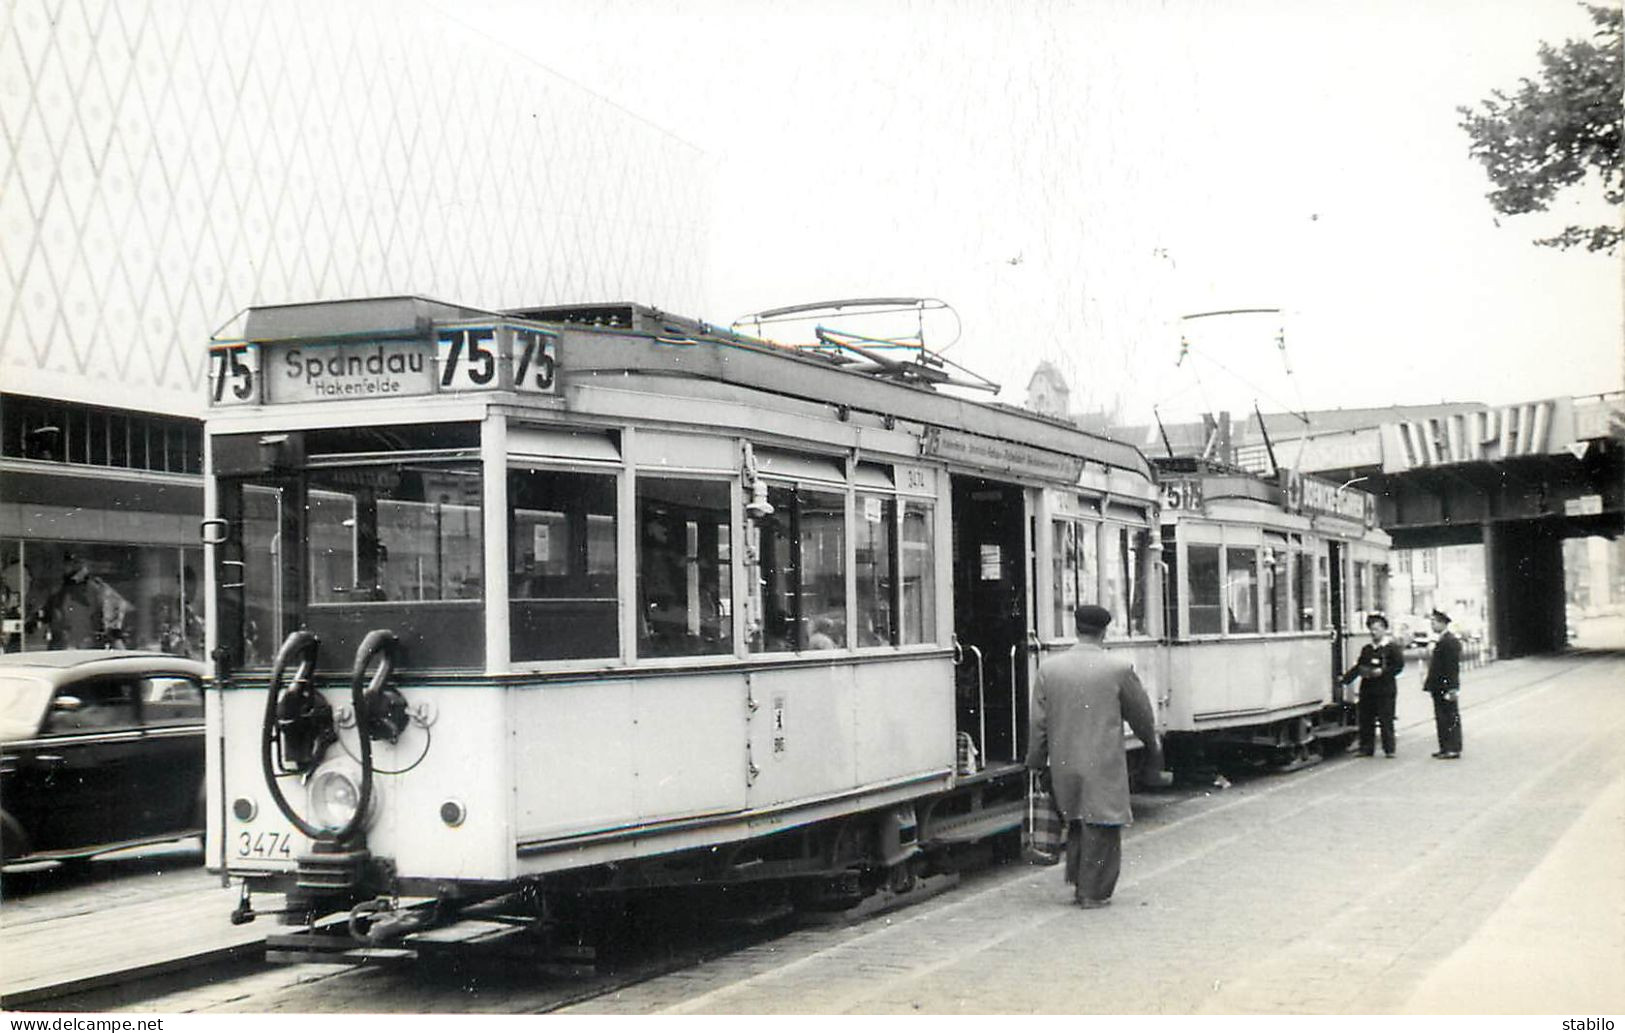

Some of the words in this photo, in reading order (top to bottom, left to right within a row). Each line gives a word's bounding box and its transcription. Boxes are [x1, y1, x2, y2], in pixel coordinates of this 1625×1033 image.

[209, 346, 254, 401] 75
[285, 346, 425, 384] Spandau
[439, 330, 496, 387] 75
[512, 331, 555, 390] 75
[314, 378, 400, 397] Hakenfelde
[238, 831, 291, 858] 3474
